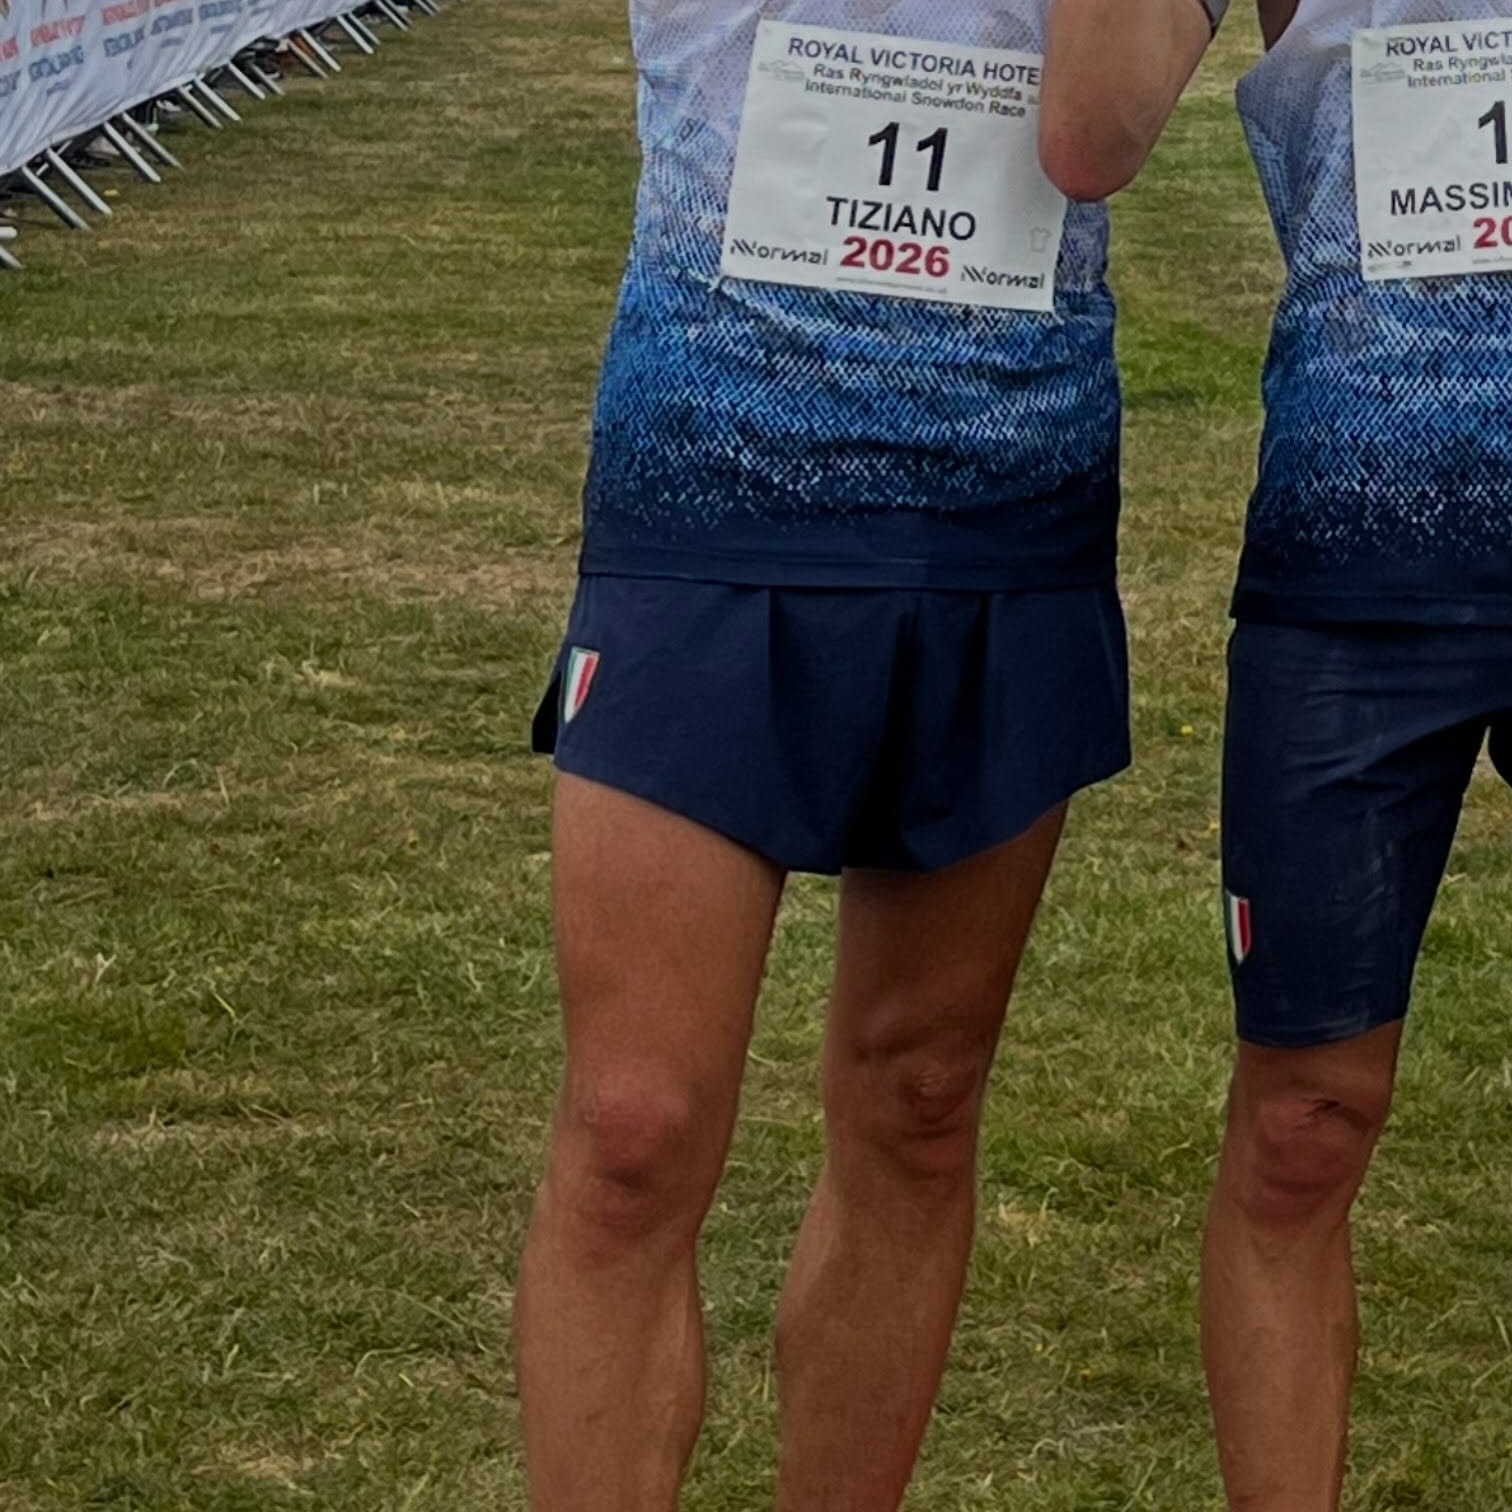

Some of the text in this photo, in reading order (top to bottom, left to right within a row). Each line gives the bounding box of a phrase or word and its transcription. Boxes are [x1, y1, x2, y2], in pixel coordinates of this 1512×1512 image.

[788, 37, 1041, 86] ROYAL VICTORIA HOTE
[1386, 35, 1458, 57] ROYAL
[1413, 58, 1443, 72] Ras
[813, 63, 844, 80] Ras
[1407, 70, 1506, 89] International
[804, 80, 1027, 119] International Snowdon Race
[868, 120, 948, 192] 11
[826, 195, 977, 240] TIZIANO
[840, 235, 950, 278] 2026
